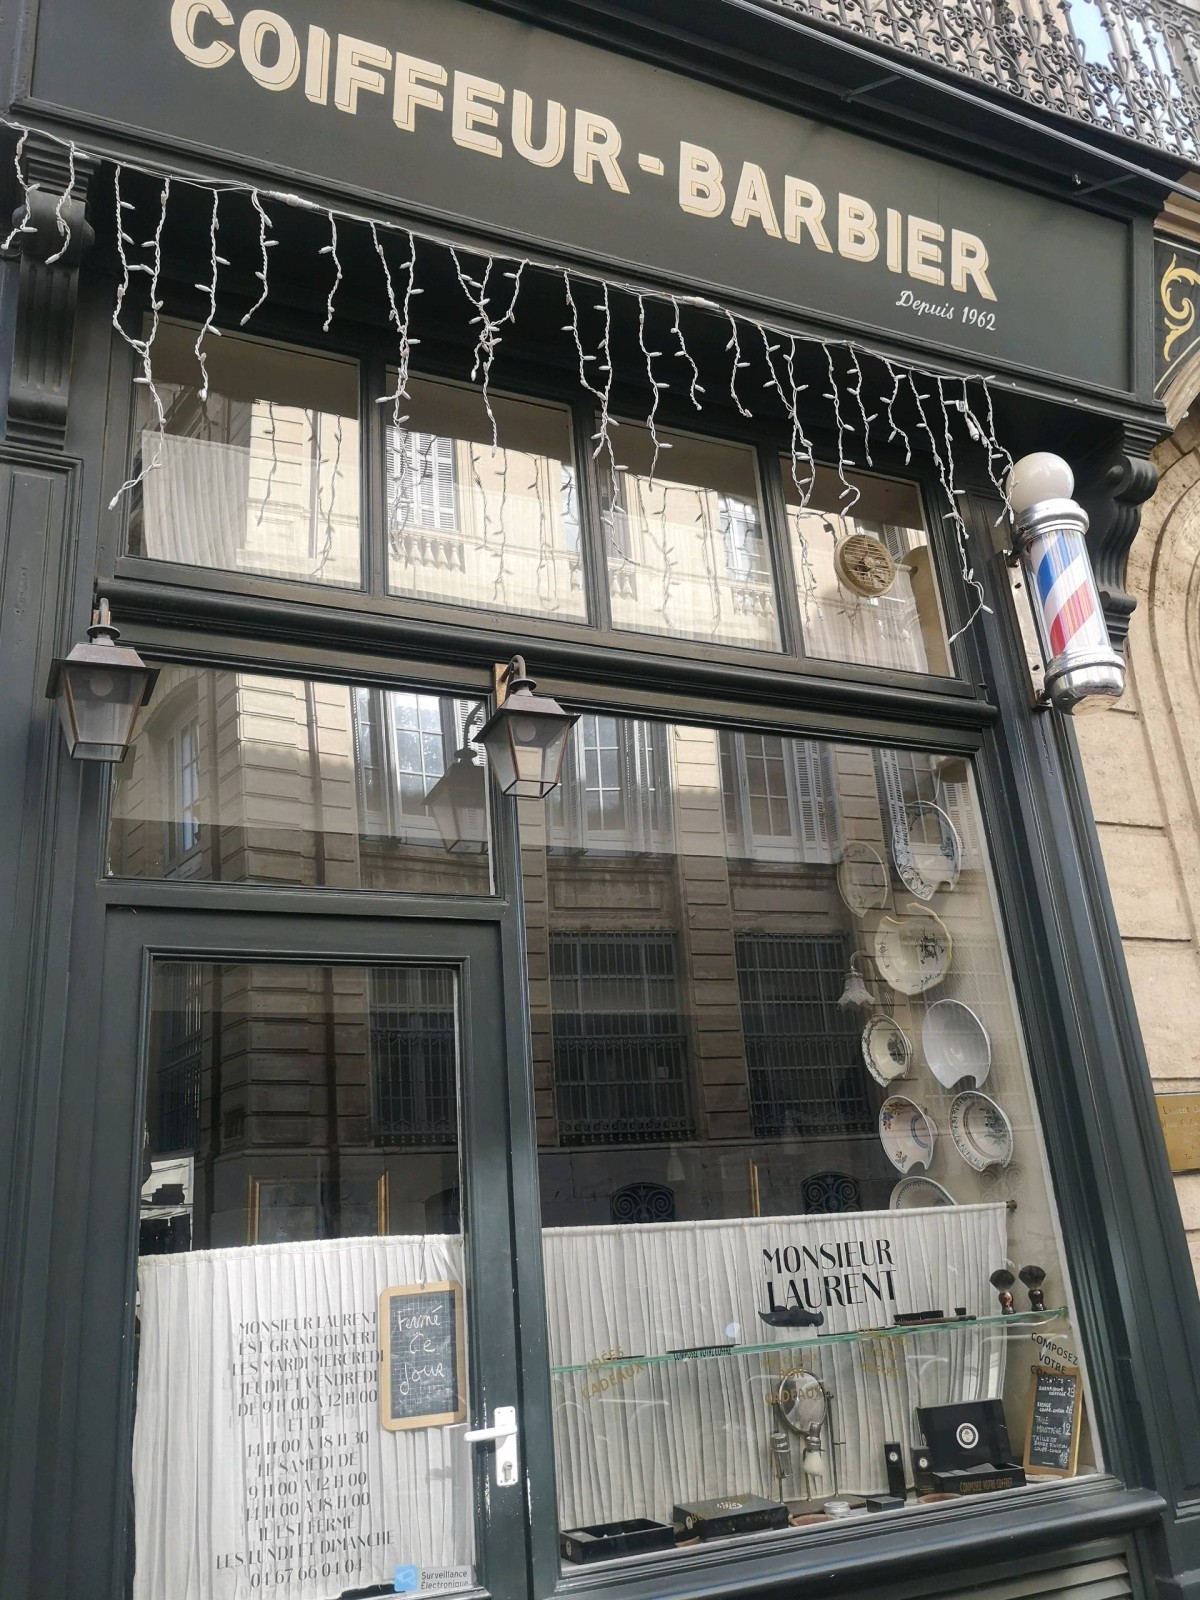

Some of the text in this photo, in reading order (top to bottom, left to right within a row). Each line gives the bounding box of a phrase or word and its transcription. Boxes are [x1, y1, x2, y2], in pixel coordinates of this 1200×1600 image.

[895, 290, 996, 331] Depuis 1962
[762, 1239, 895, 1275] MONSIEUR
[767, 1270, 896, 1313] LAURENT
[239, 1311, 377, 1335] MONSIEUR LAURENT
[239, 1331, 377, 1355] EST GRAND OUVERT
[1031, 1332, 1078, 1365] COMPOSEZ
[232, 1349, 384, 1376] LES MARDI MERCREDI
[1039, 1352, 1066, 1375] VOTRE
[240, 1369, 378, 1399] JEUDI ET VENDREDI
[581, 1361, 645, 1399] CADEAUX
[238, 1402, 257, 1417] DE
[262, 1401, 272, 1414] 9
[276, 1398, 286, 1413] H
[291, 1396, 309, 1411] 00
[328, 1393, 341, 1407] 12
[345, 1391, 355, 1405] H
[359, 1389, 378, 1404] 00
[288, 1414, 330, 1432] ET DE
[247, 1443, 260, 1457] 14
[266, 1441, 276, 1455] H
[281, 1438, 301, 1454] 00
[319, 1434, 333, 1449] 18
[337, 1432, 347, 1446] H
[353, 1430, 369, 1445] 30
[258, 1452, 358, 1477] LE SAMEDI DE
[248, 1486, 258, 1500] 9
[263, 1484, 273, 1498] H
[278, 1481, 297, 1496] 00
[317, 1476, 330, 1491] 12
[334, 1474, 344, 1488] H
[348, 1472, 367, 1487] 00
[246, 1507, 260, 1521] 14
[265, 1505, 275, 1519] H
[280, 1502, 299, 1517] 00
[319, 1497, 333, 1511] 18
[337, 1495, 347, 1509] H
[351, 1492, 370, 1507] 00
[259, 1527, 273, 1541] IL
[277, 1522, 303, 1539] EST
[216, 1529, 396, 1569] LES LUNDI ET DIMANCHE
[251, 1558, 364, 1588] 04 67 66 04 04
[422, 1570, 468, 1580] Surveillance
